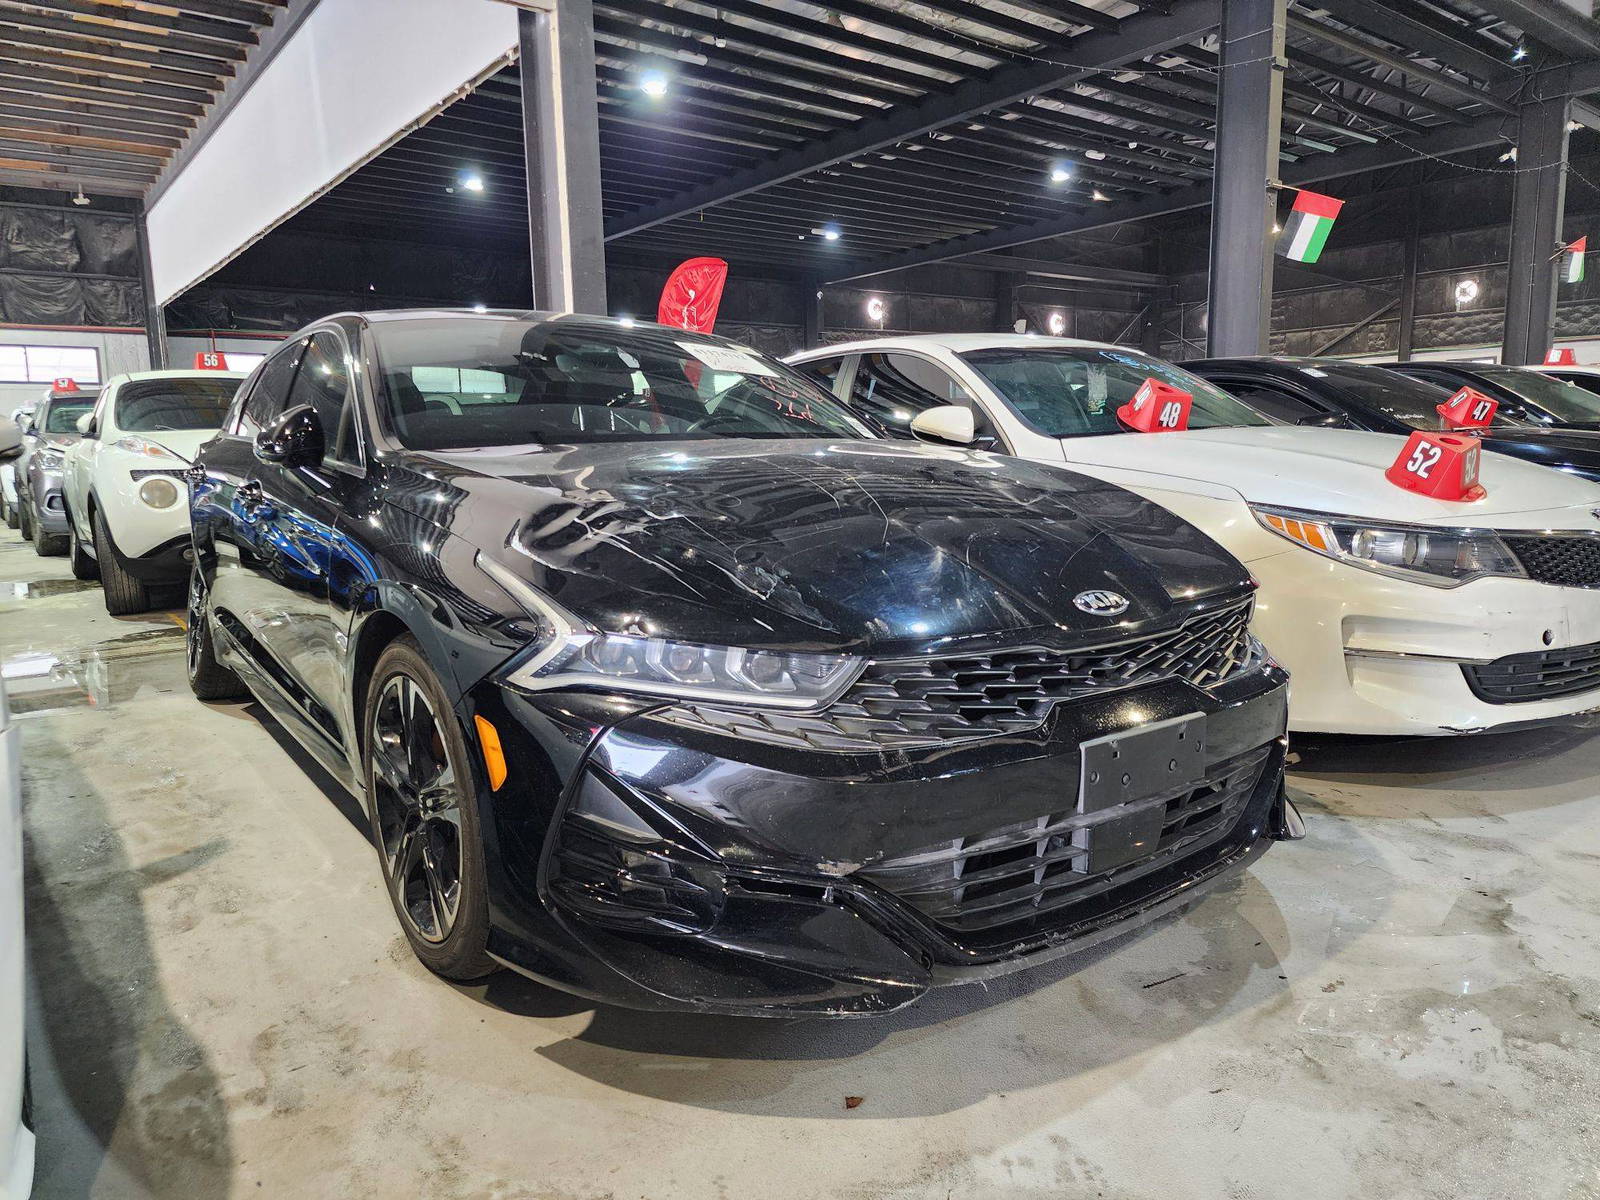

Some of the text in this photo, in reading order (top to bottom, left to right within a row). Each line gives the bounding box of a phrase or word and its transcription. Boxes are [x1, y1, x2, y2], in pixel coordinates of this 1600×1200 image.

[203, 354, 219, 368] 56
[1159, 401, 1182, 428] 48
[1472, 400, 1491, 421] 47
[1406, 440, 1442, 479] 52
[1464, 447, 1477, 485] 52
[1078, 592, 1124, 611] KIA
